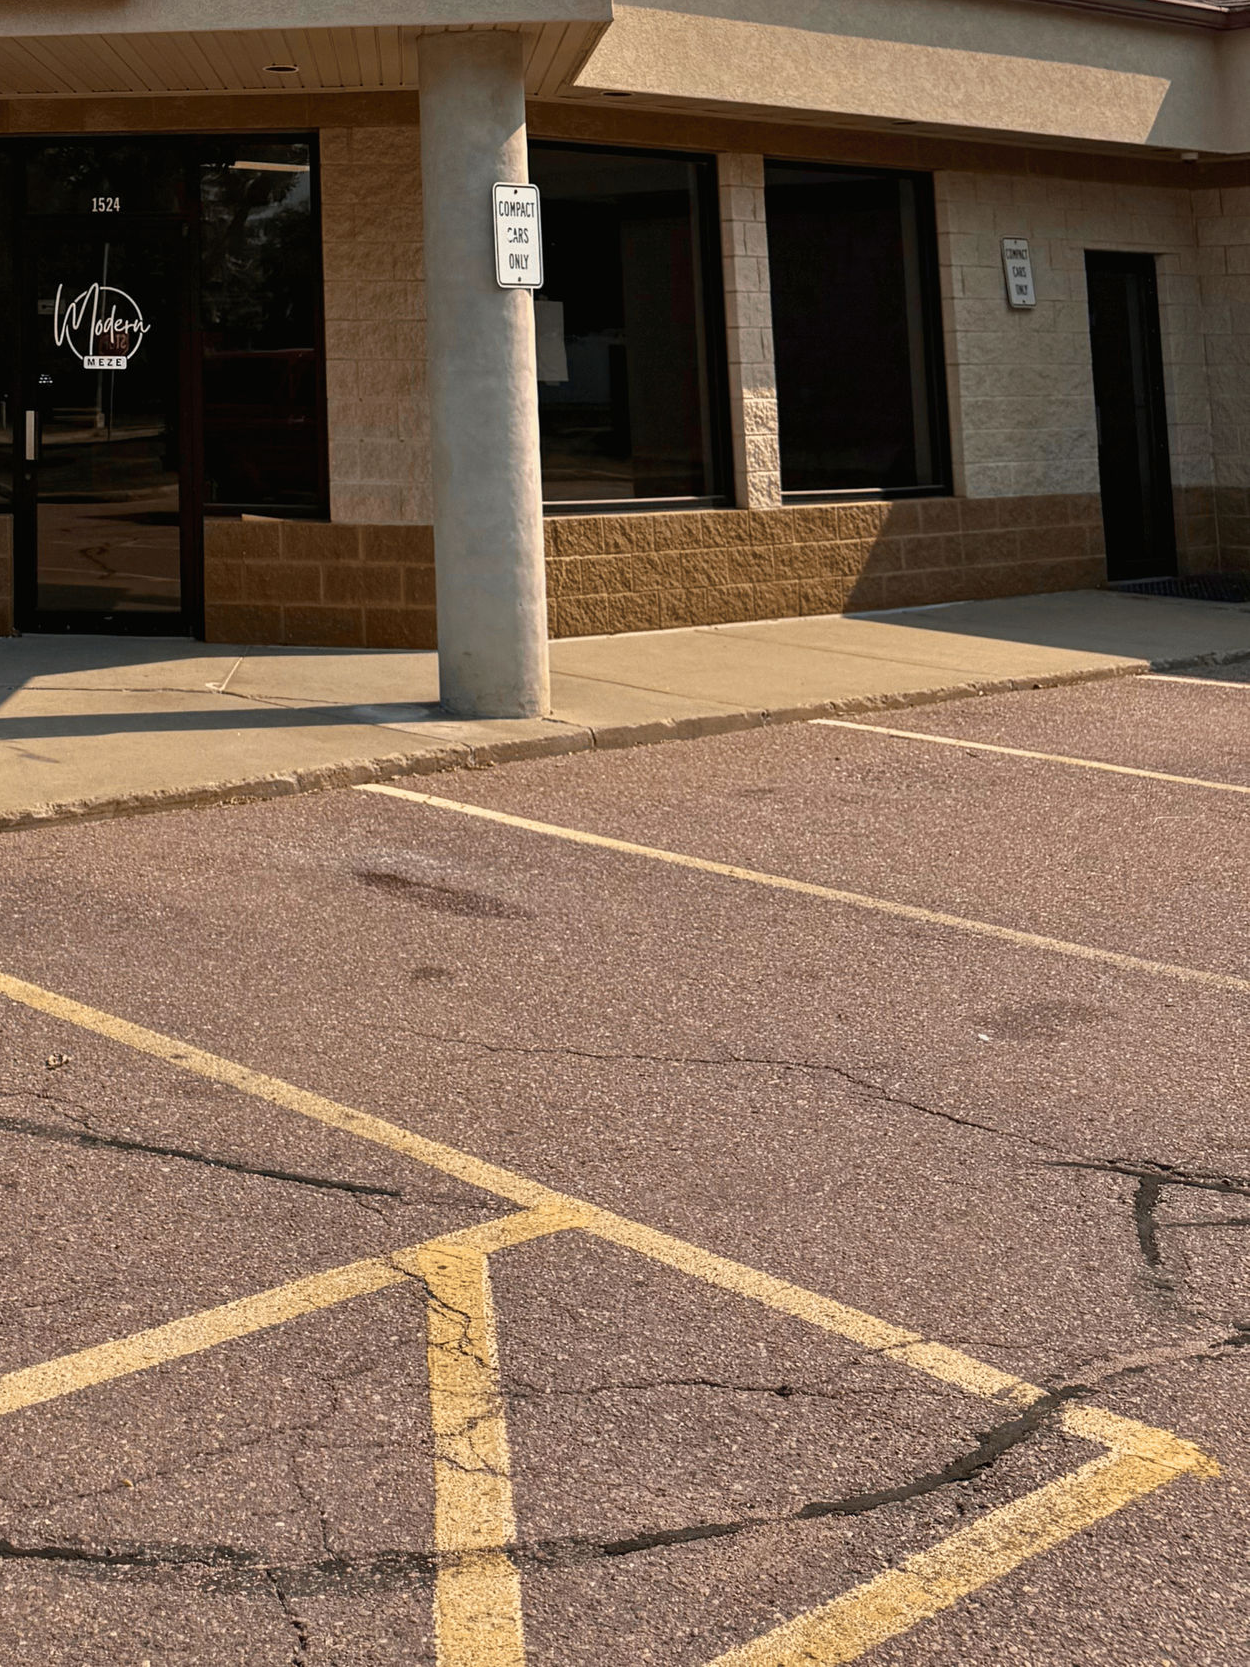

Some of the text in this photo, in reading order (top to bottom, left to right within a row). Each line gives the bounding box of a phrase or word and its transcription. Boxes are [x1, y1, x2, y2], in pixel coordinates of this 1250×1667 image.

[91, 196, 121, 213] 1524
[498, 200, 535, 218] COMPACT
[1005, 248, 1028, 260] COMPACT
[508, 253, 530, 270] ONLY
[1012, 266, 1027, 278] CARS
[1015, 284, 1029, 296] ONLY
[53, 282, 152, 356] Modern
[86, 358, 124, 368] MEZE
